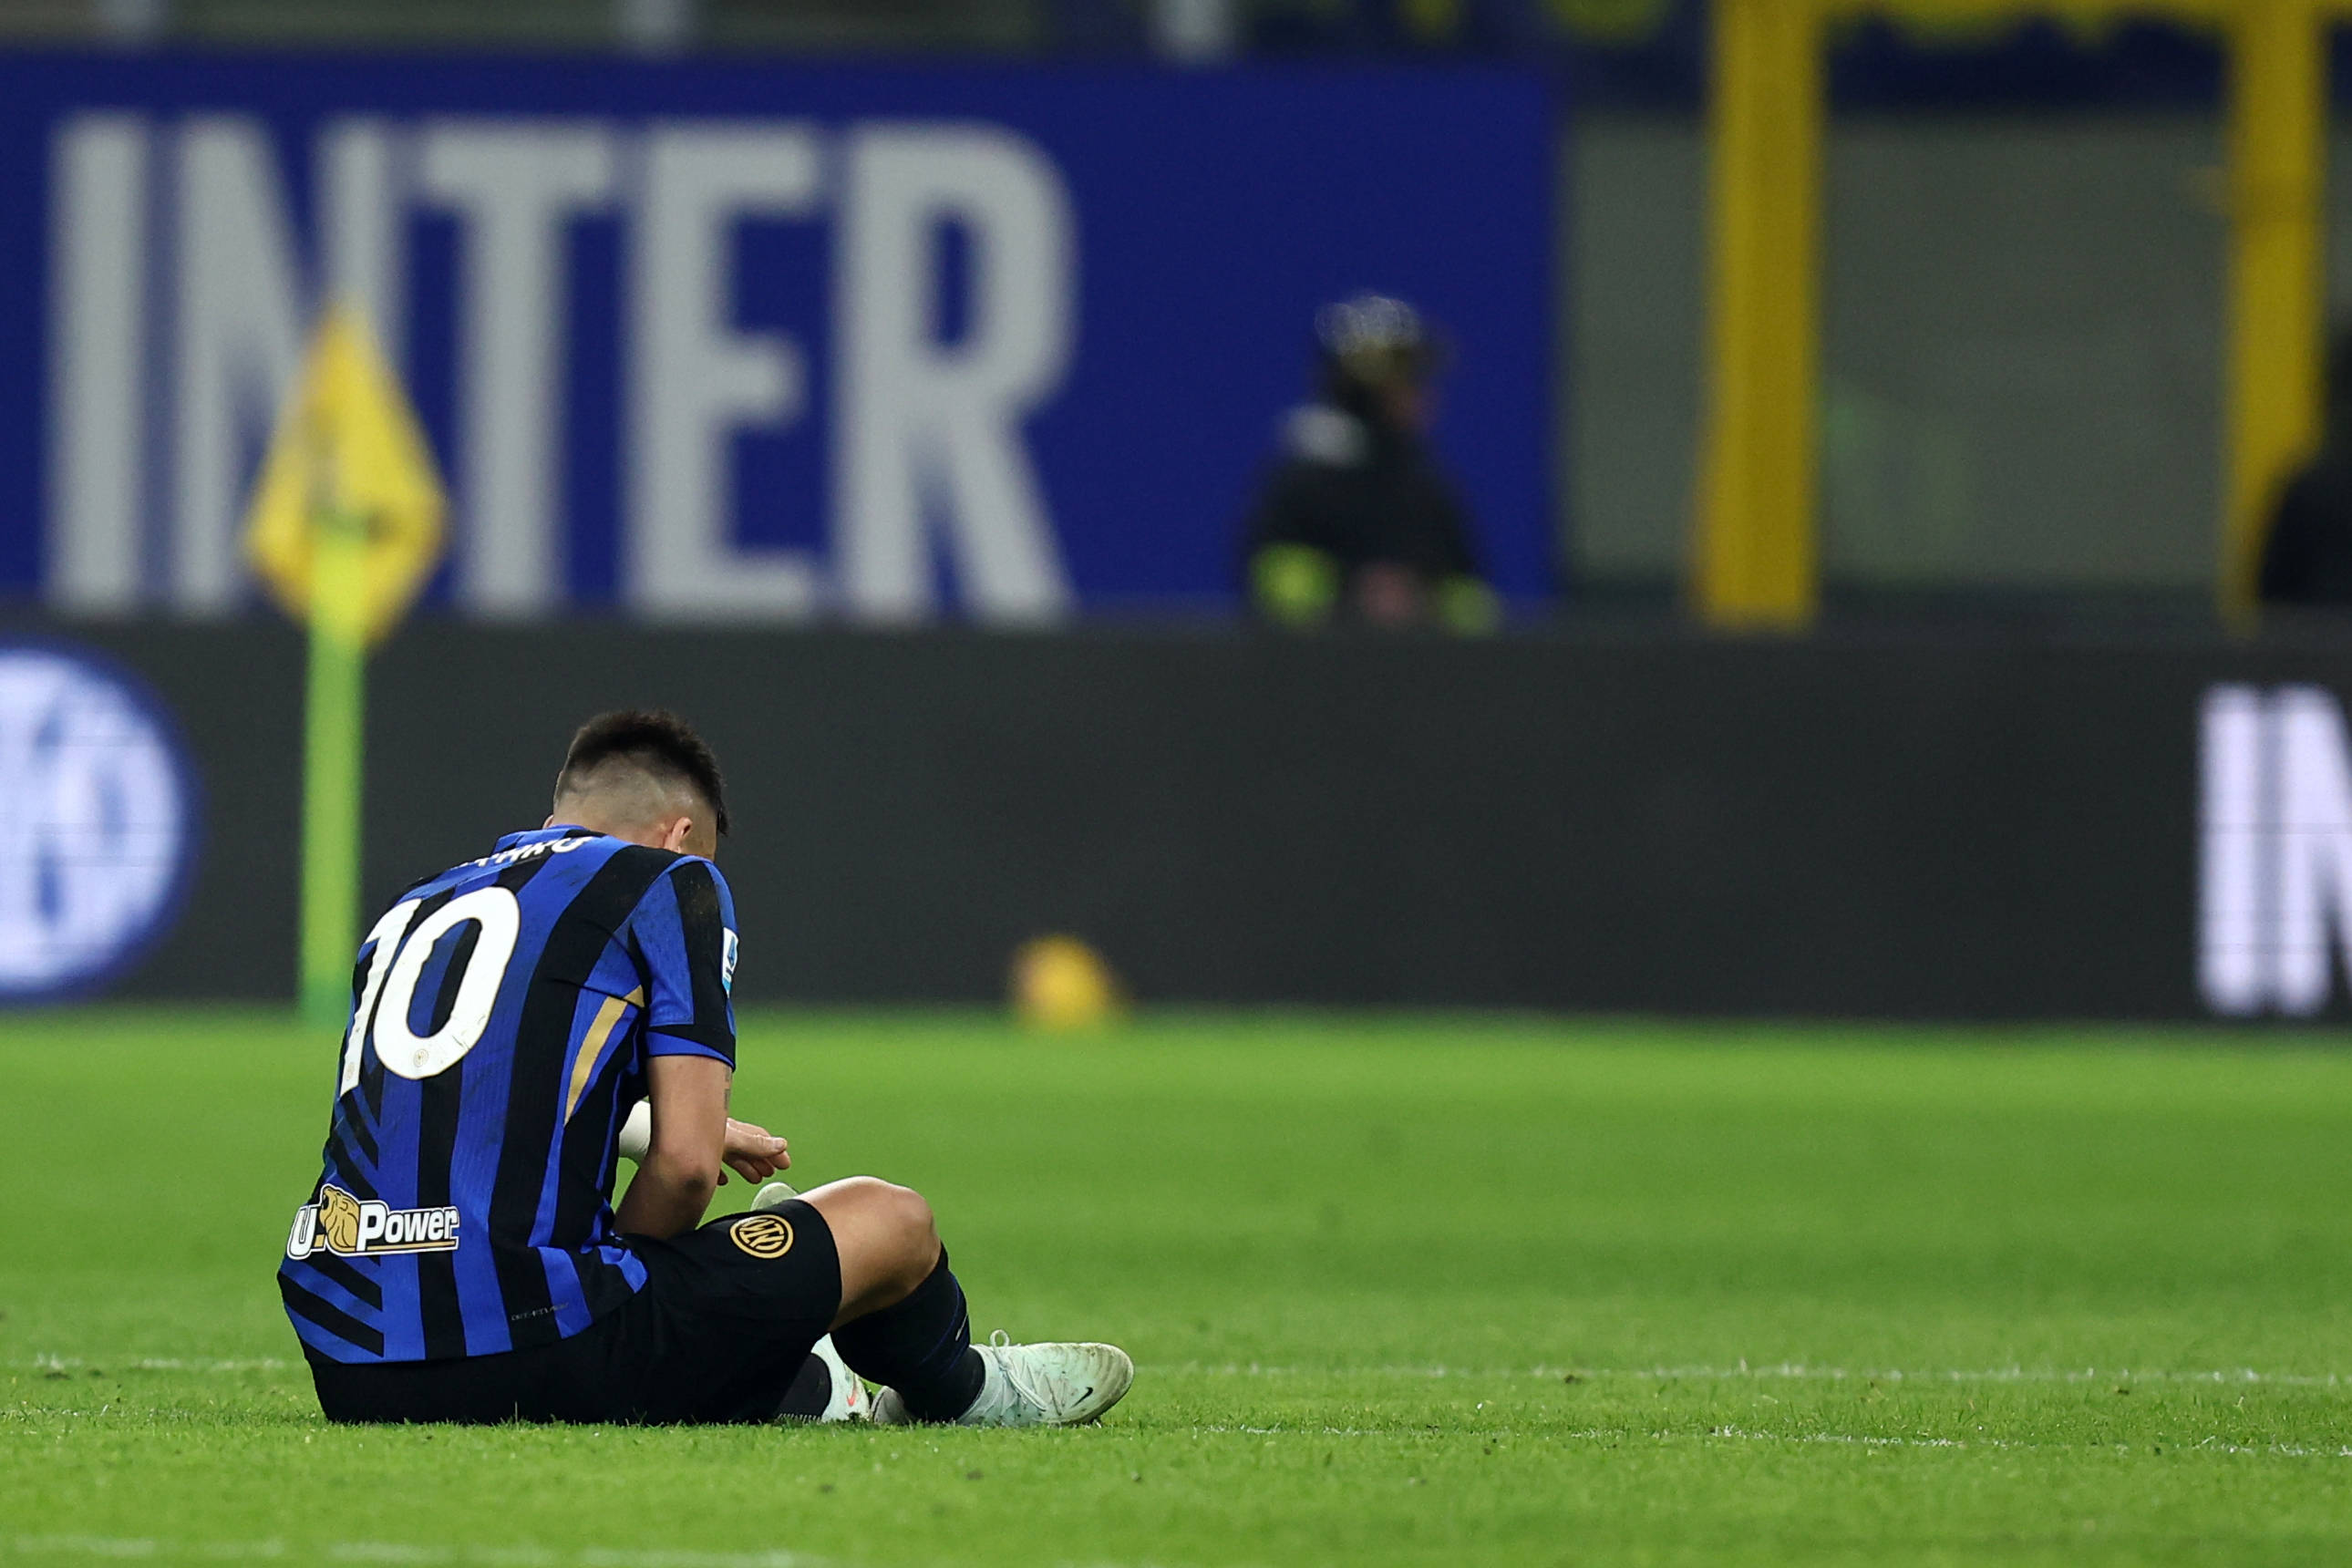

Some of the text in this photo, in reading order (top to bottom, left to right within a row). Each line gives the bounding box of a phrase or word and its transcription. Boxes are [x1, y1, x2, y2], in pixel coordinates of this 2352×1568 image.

[46, 111, 1083, 620] INTER
[340, 886, 521, 1097] 10
[356, 1195, 458, 1252] Power
